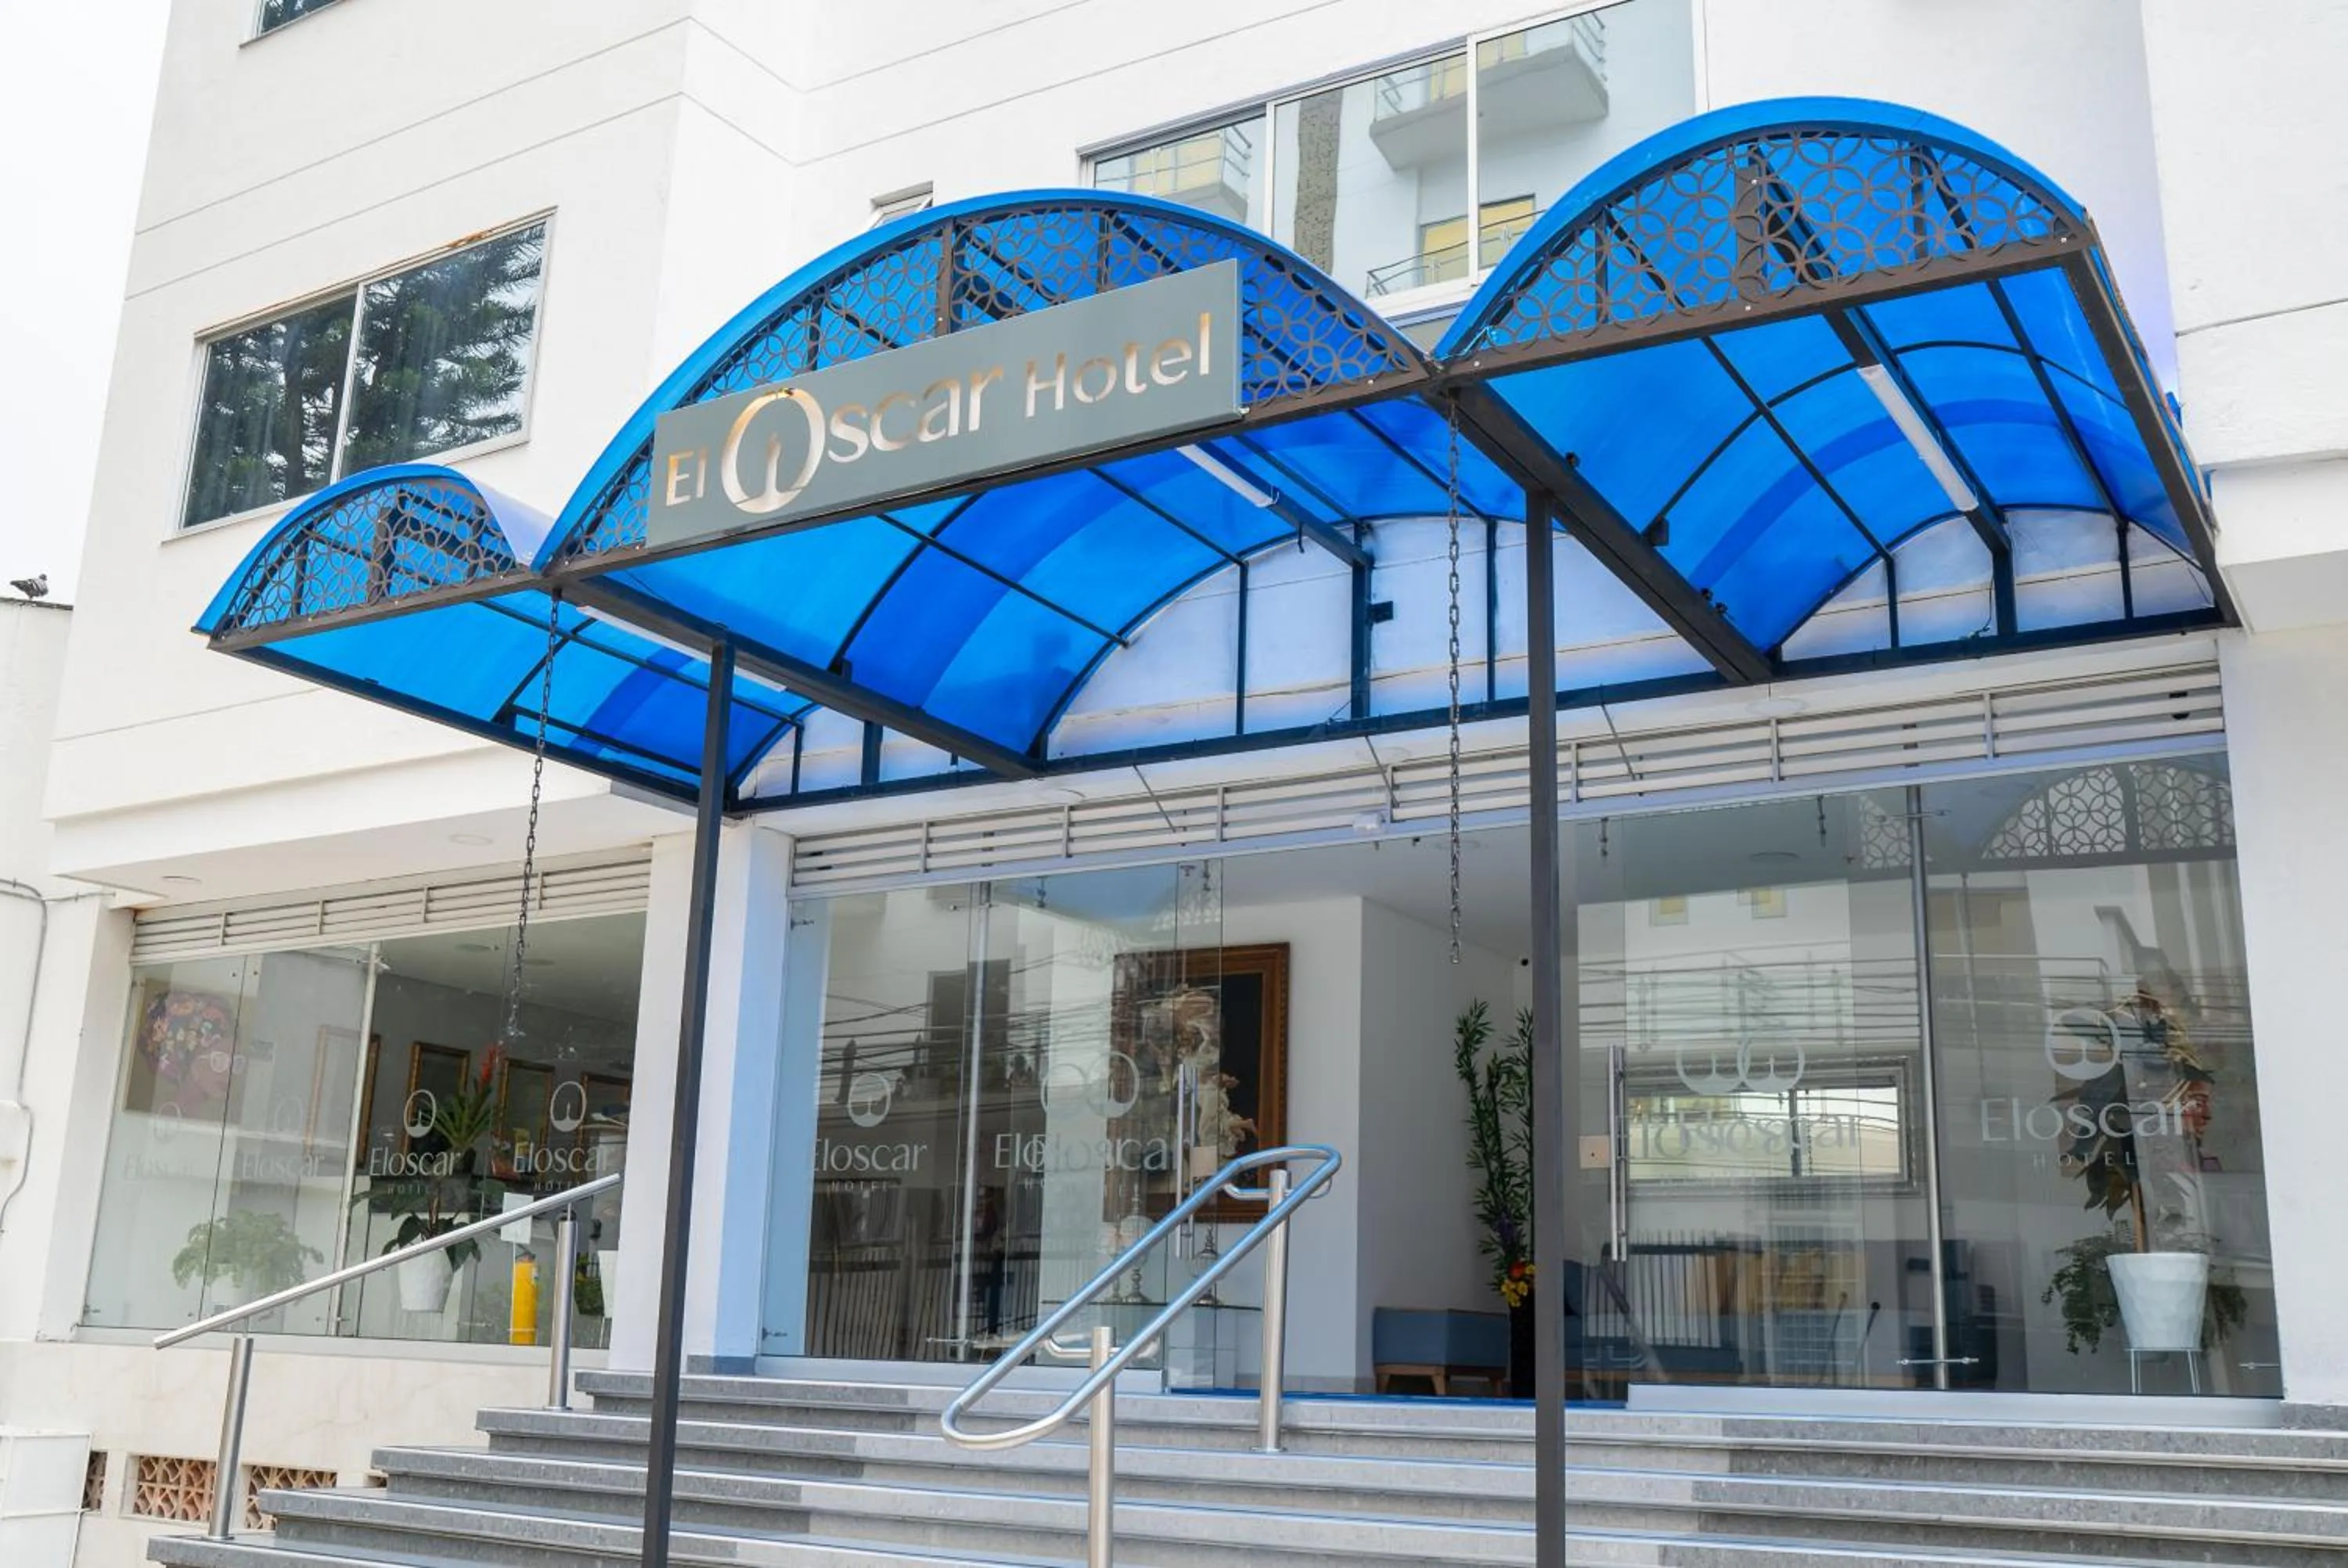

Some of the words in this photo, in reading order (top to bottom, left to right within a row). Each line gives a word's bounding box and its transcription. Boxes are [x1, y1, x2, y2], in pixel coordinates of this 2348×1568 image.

[665, 448, 707, 507] El
[721, 364, 1005, 515] Oscar
[1026, 312, 1212, 419] Hotel
[2033, 1150, 2136, 1167] HOTEL
